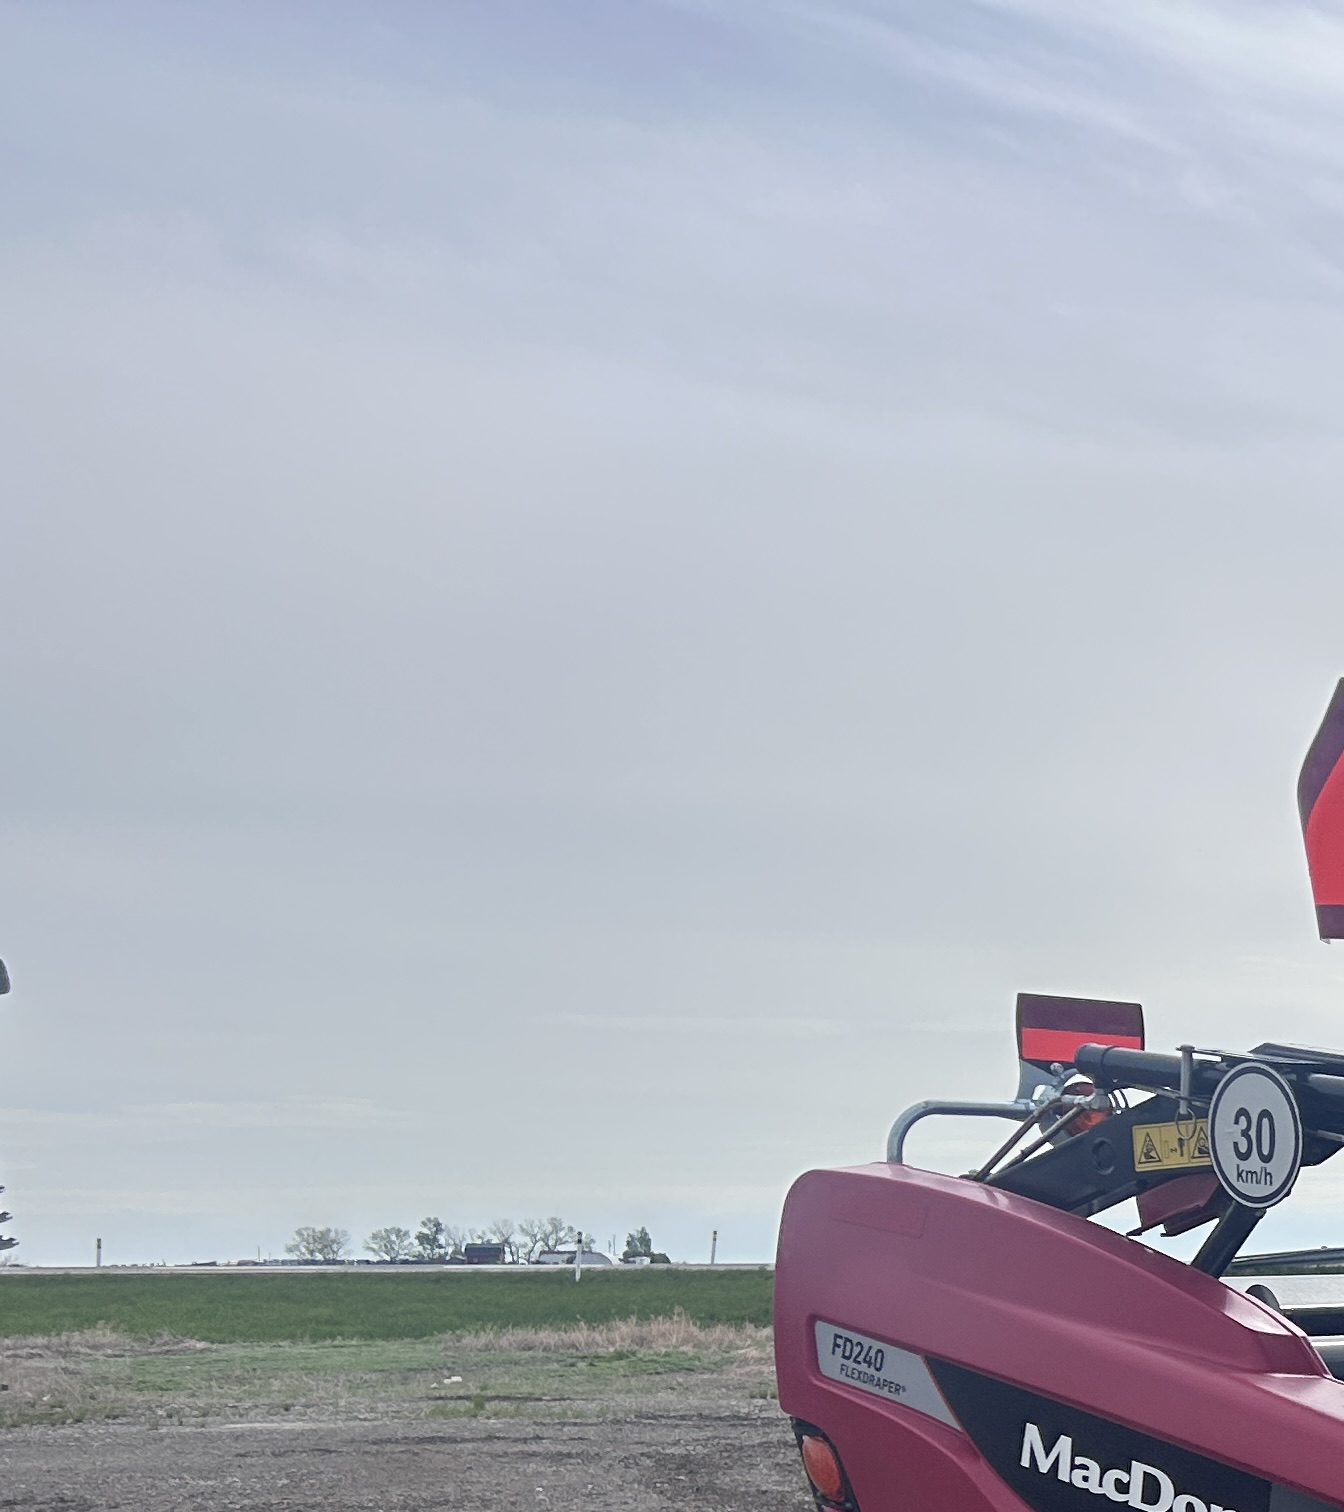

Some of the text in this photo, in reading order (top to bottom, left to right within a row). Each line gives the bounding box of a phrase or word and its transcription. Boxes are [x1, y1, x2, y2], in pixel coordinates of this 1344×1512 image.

[1233, 1107, 1276, 1164] 30
[1236, 1163, 1273, 1187] km/h
[831, 1333, 885, 1372] FD240
